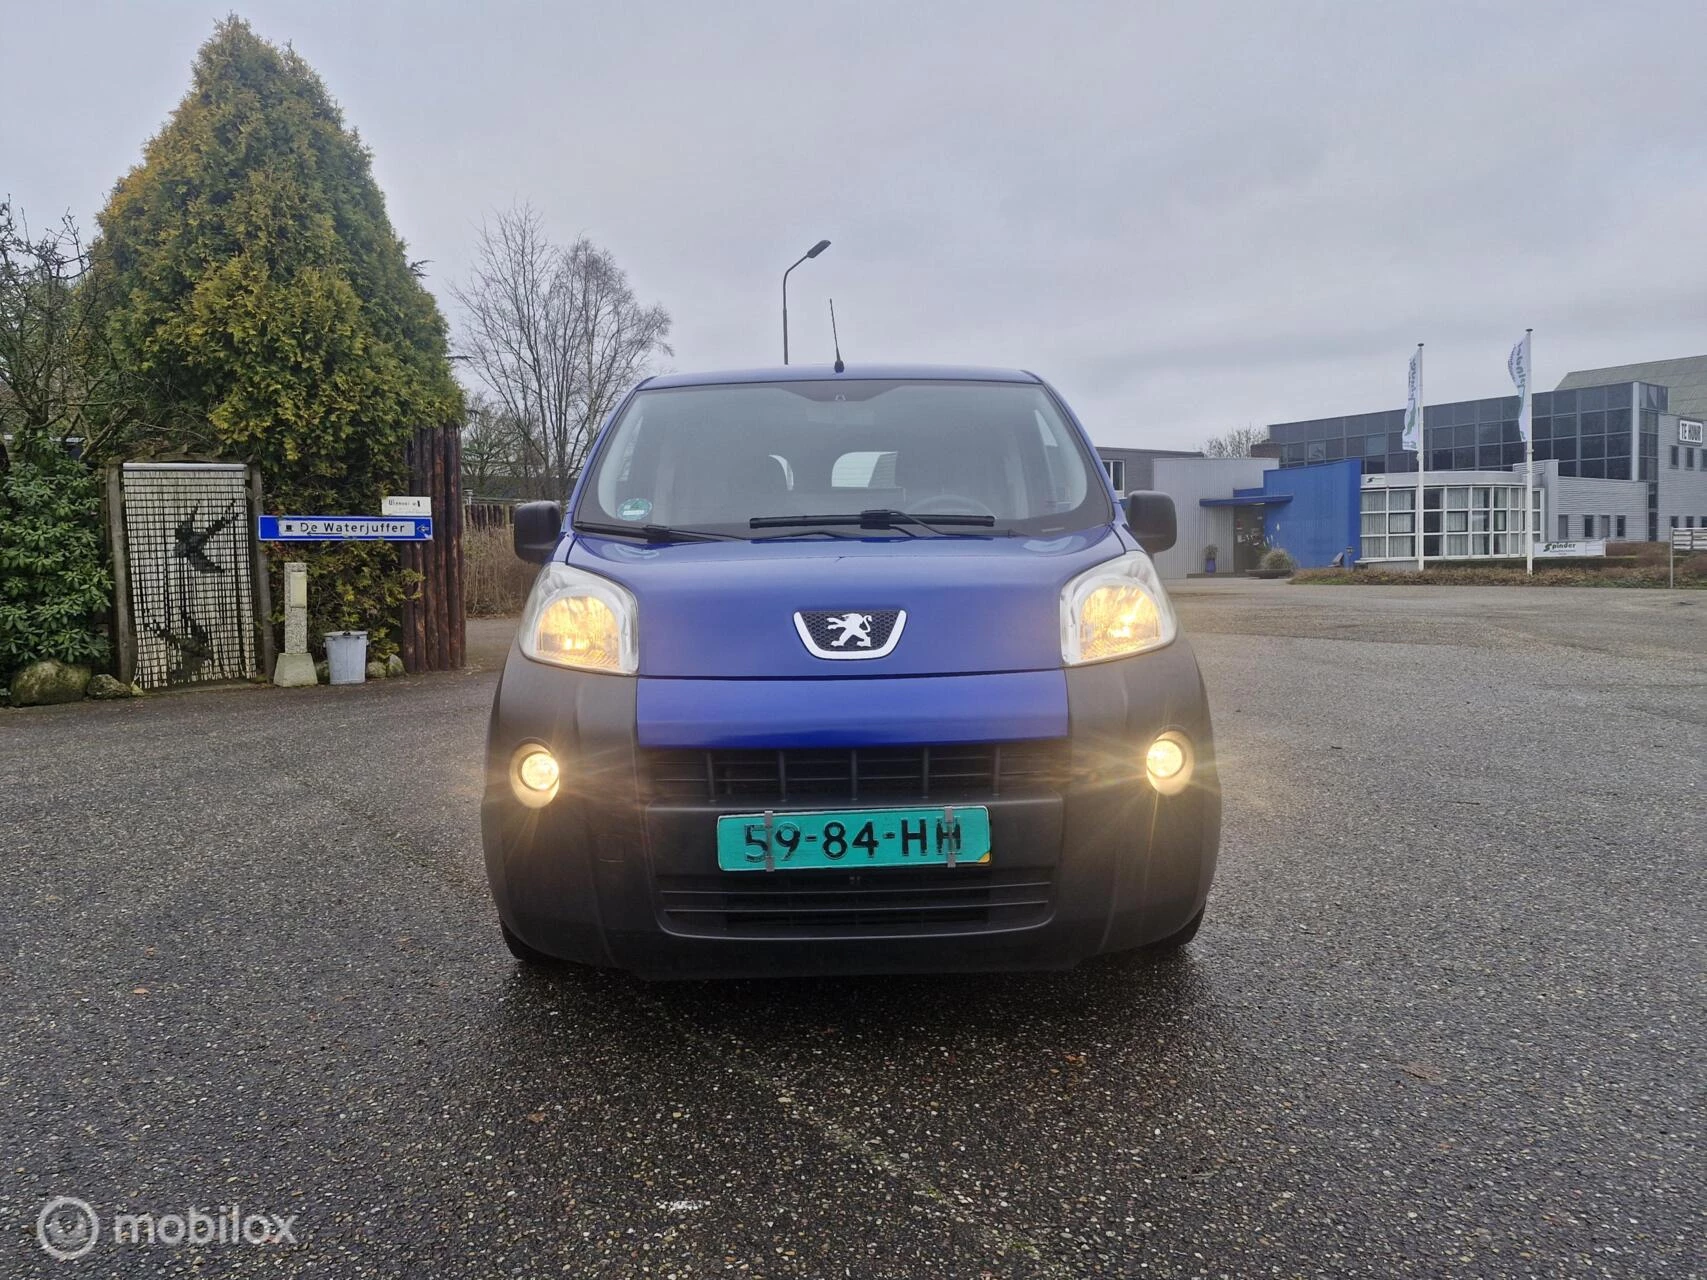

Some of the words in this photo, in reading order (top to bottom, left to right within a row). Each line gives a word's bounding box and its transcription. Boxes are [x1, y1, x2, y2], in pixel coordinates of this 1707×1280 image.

[1681, 423, 1688, 440] TE
[300, 522, 318, 533] De
[324, 522, 405, 535] Waterjuffer
[744, 817, 961, 862] 59-84-HH
